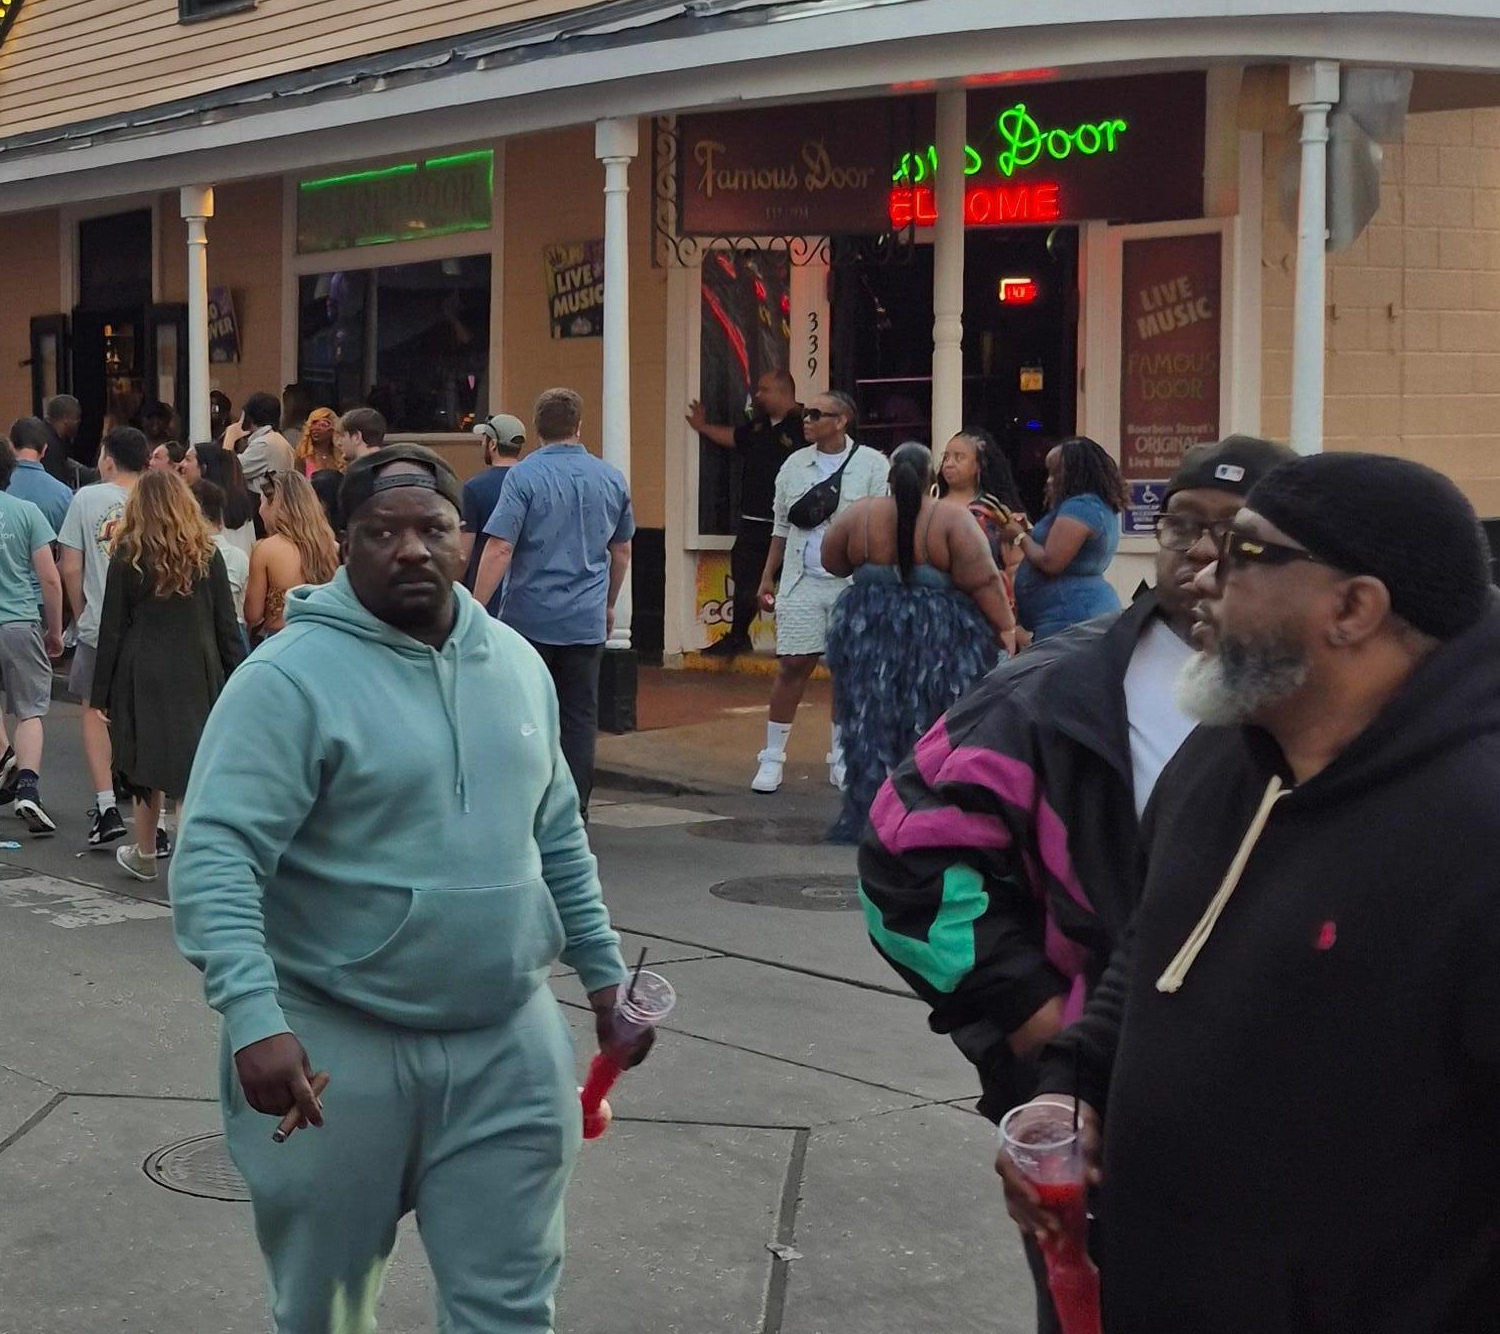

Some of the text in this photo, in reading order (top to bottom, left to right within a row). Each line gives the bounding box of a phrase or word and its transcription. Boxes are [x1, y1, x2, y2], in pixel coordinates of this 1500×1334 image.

[999, 102, 1128, 178] Door
[693, 139, 798, 199] Famous
[801, 135, 875, 192] Door
[891, 185, 1060, 223] ELOME
[556, 264, 593, 295] LIVE
[1139, 276, 1192, 312] LIVE
[553, 283, 604, 319] MUSIC
[1137, 297, 1212, 340] MUSIC
[807, 311, 819, 379] 339
[1141, 377, 1204, 401] DOOR
[1153, 455, 1181, 468] Musi
